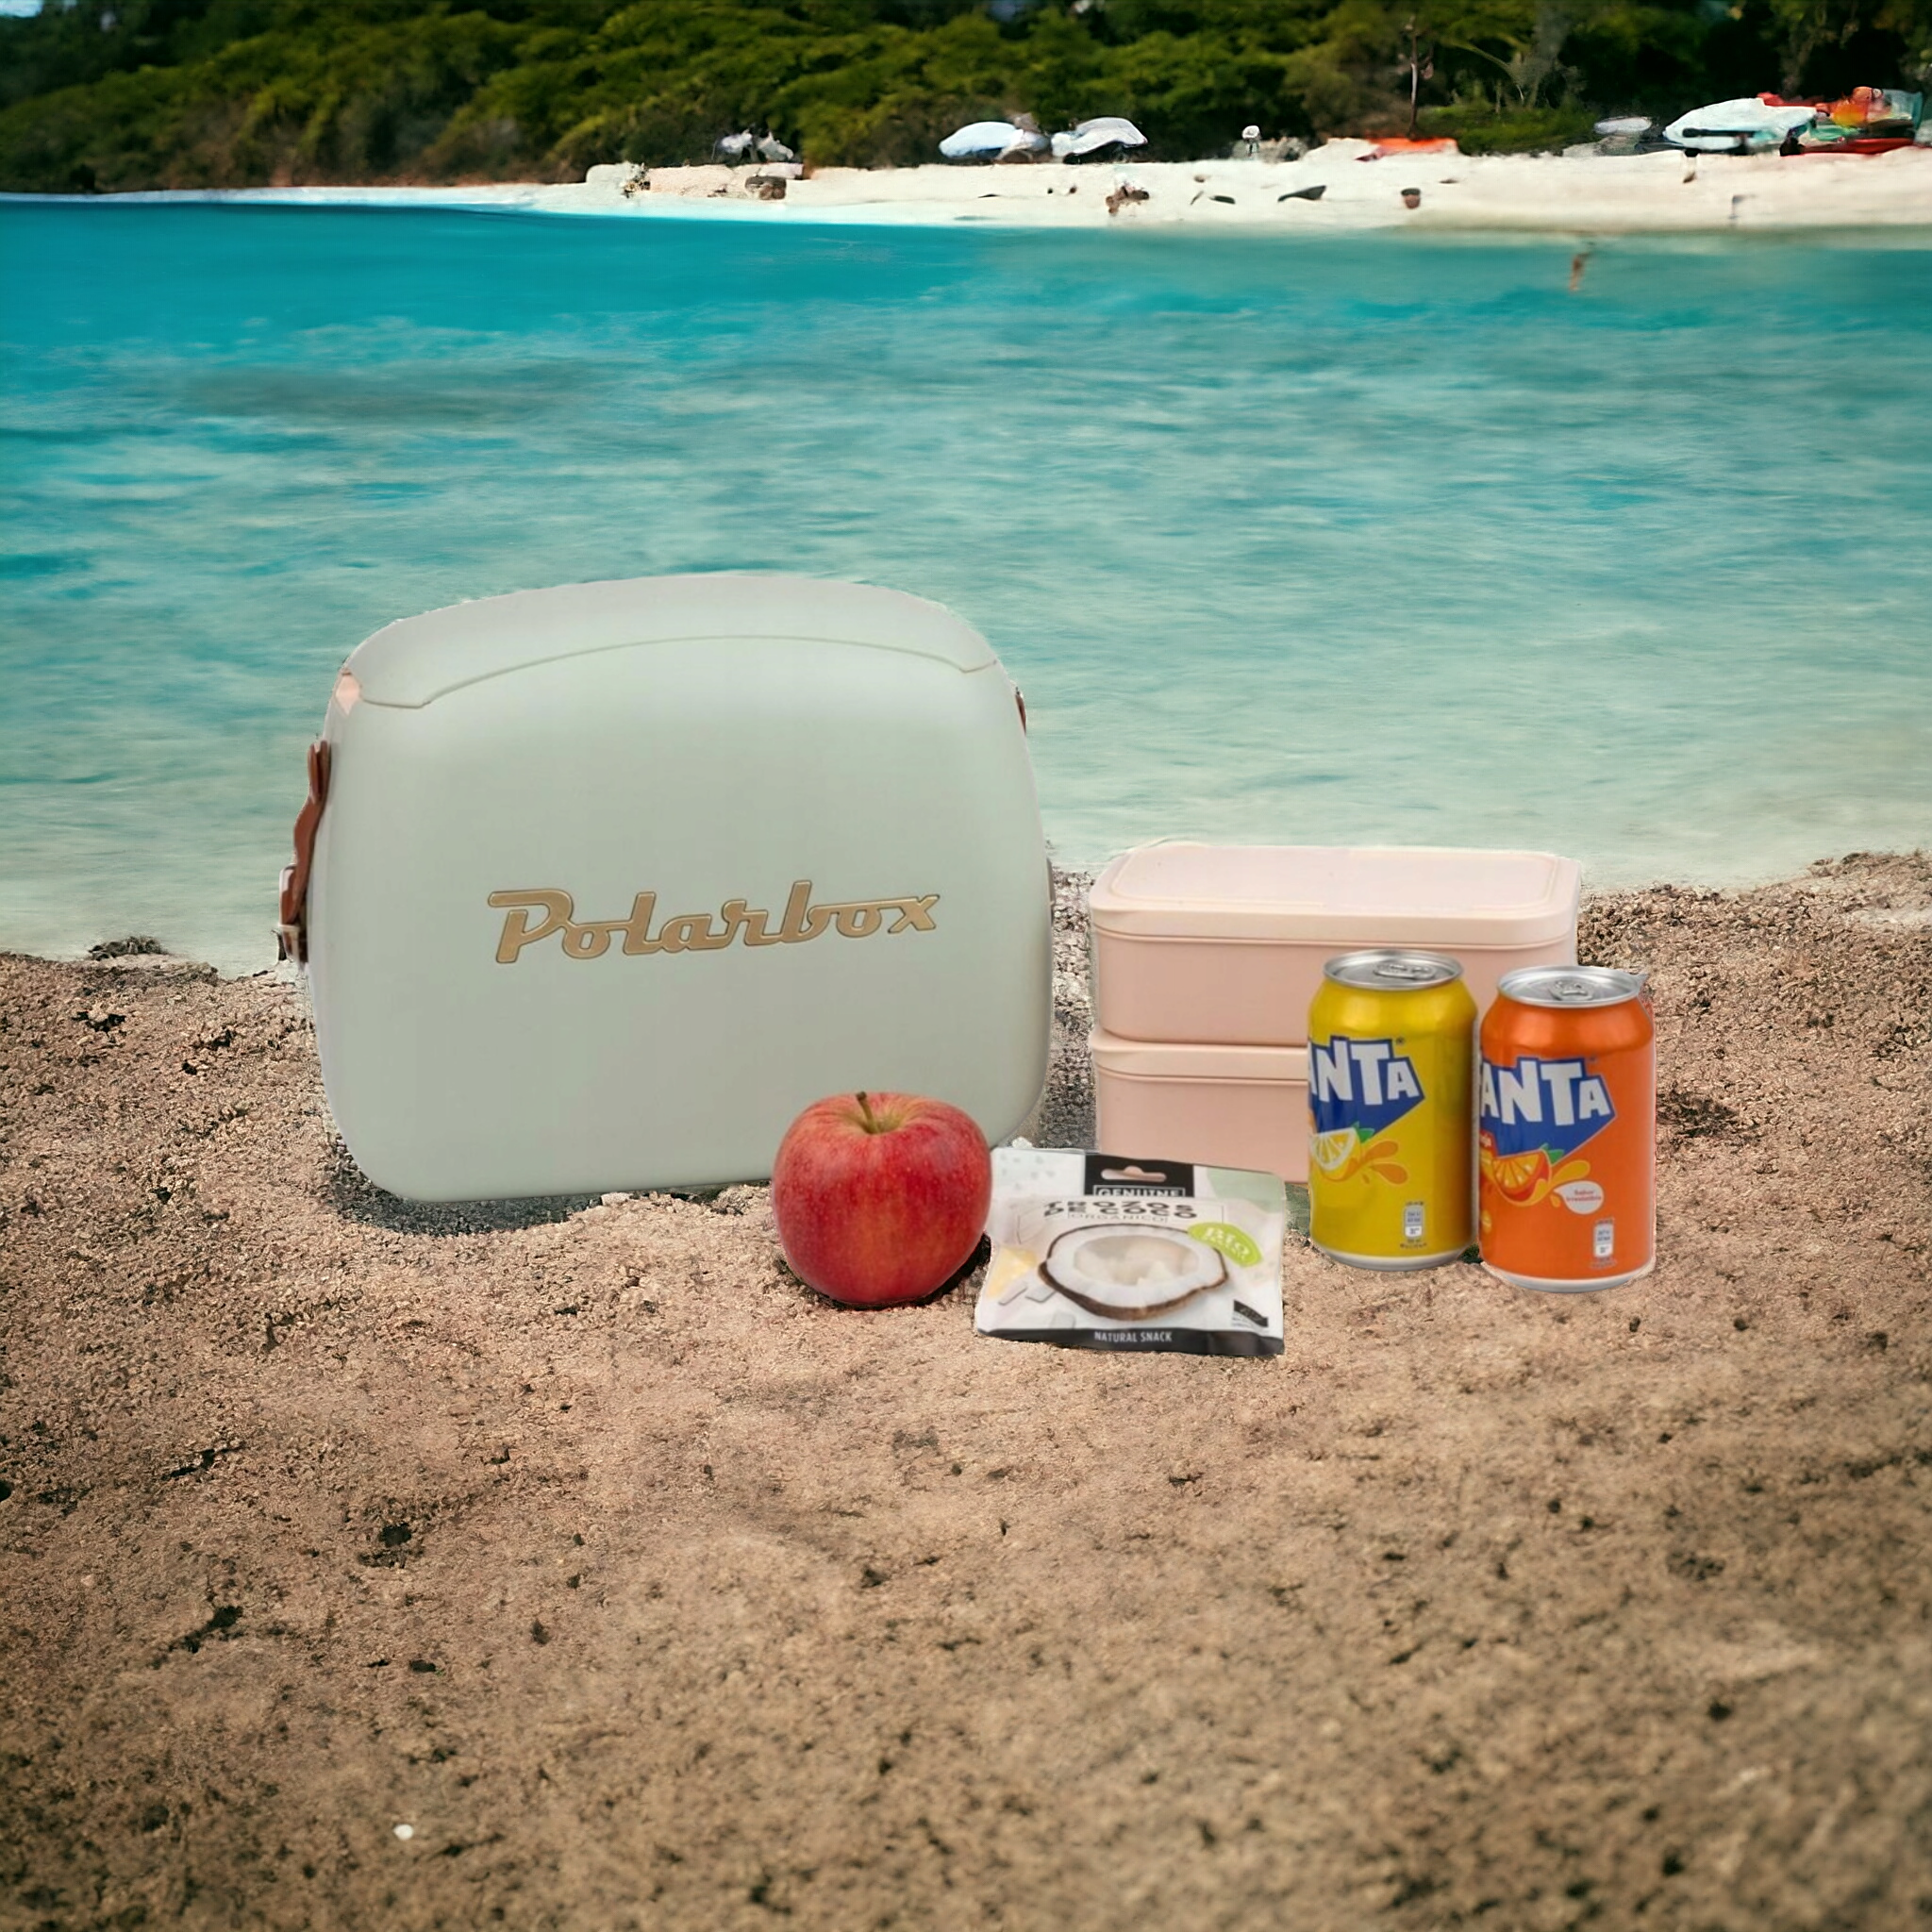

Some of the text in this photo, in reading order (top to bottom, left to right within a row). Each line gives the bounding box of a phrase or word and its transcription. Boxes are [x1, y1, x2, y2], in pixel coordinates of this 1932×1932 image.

[488, 880, 940, 963] Polarbox
[1100, 1207, 1197, 1219] COCO
[1094, 1331, 1172, 1342] NATURAL SNACK
